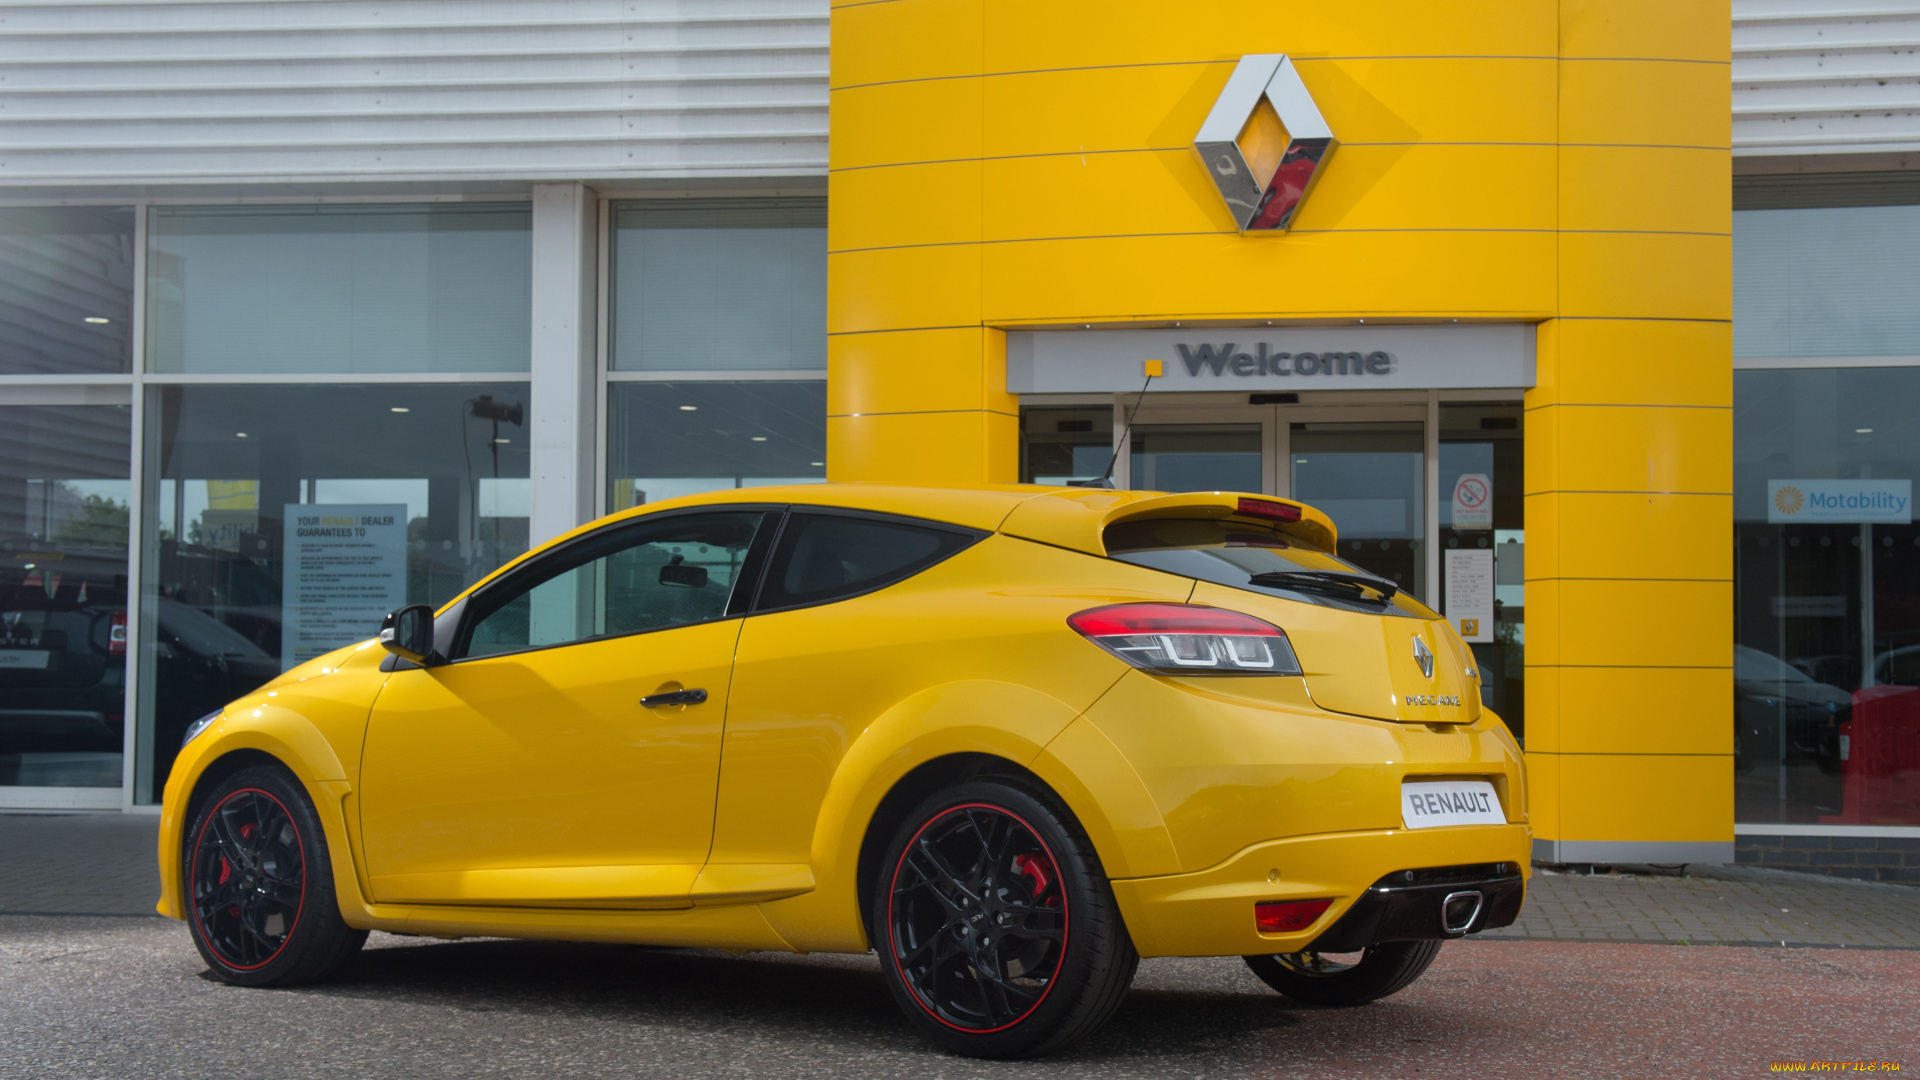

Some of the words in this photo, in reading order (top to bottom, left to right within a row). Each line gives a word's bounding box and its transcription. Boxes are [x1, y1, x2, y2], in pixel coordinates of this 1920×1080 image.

[1178, 342, 1391, 376] Welcome
[1810, 491, 1907, 514] Motability
[297, 516, 320, 526] YOUR
[321, 516, 359, 526] RENAULT
[361, 516, 394, 526] DEALER
[297, 527, 352, 537] GUARANTEES
[354, 528, 366, 537] TO
[1405, 695, 1461, 706] MEGANE
[1409, 792, 1491, 815] RENAULT
